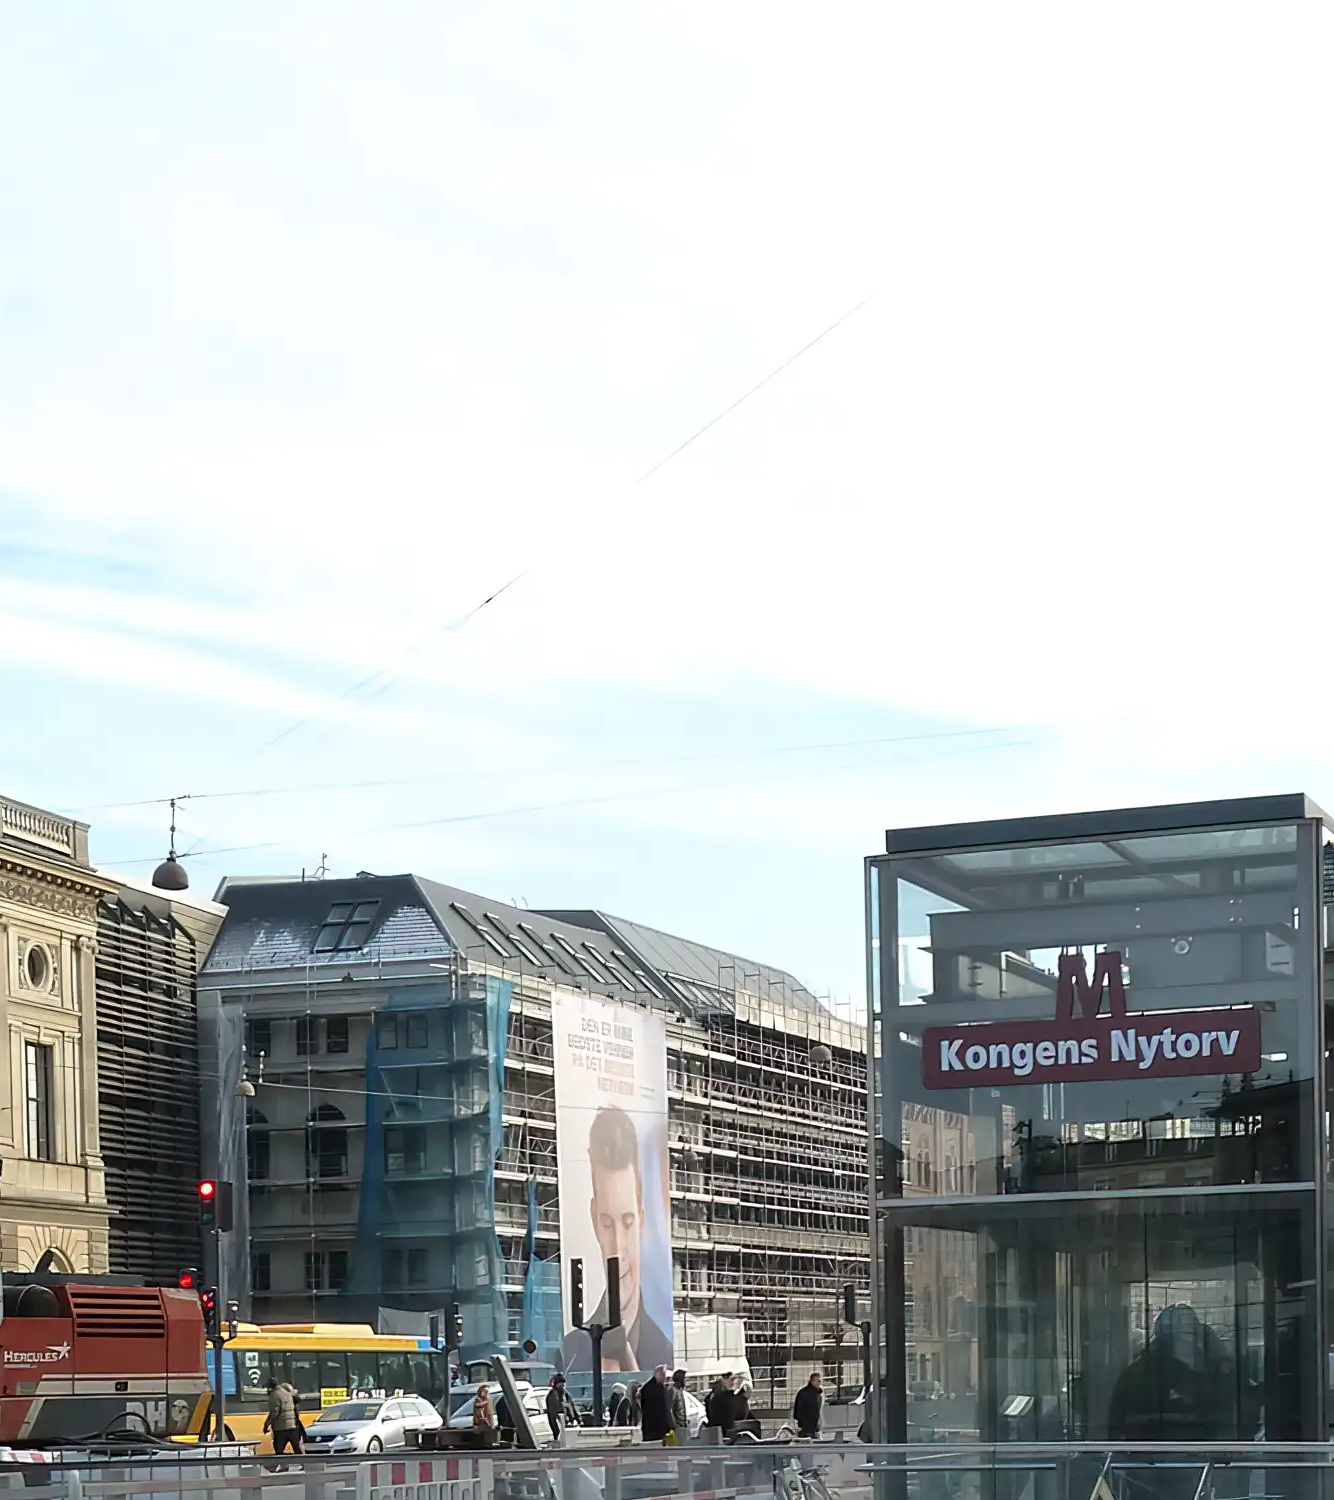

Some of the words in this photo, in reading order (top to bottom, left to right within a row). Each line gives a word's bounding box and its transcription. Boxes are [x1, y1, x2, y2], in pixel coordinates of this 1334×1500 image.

[939, 1036, 1098, 1077] Kongens
[1110, 1026, 1240, 1070] Nytorv
[4, 1350, 59, 1363] HERCULES
